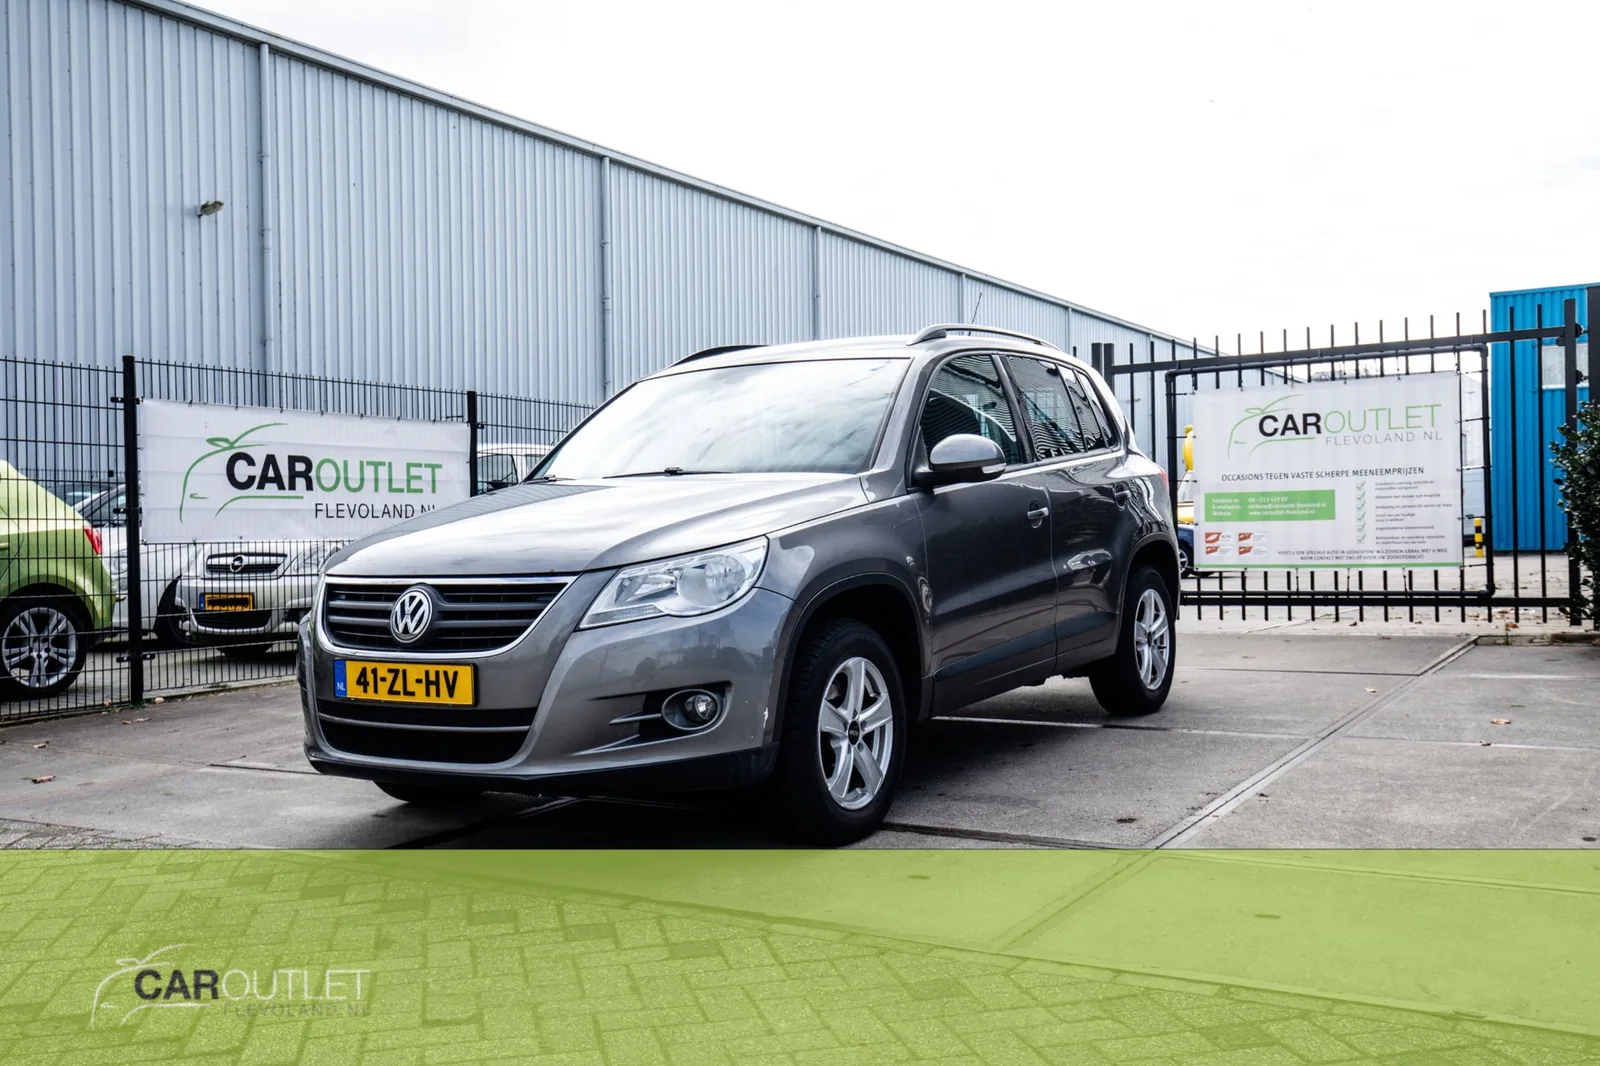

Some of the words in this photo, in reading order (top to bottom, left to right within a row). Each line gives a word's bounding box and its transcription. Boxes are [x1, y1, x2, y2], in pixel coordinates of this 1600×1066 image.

[1258, 404, 1442, 437] CAROUTLET
[1325, 431, 1443, 446] FLEVOLAND.NL
[226, 452, 442, 494] CAROUTLET
[1221, 473, 1264, 482] OCCASIONS
[1265, 472, 1289, 480] TEGEN
[1290, 471, 1314, 479] VASTE
[1315, 470, 1350, 478] SCHERPE
[1352, 466, 1424, 476] MEENEEMPRIJZEN
[336, 682, 346, 691] NL
[355, 666, 459, 699] 41-ZL-HV
